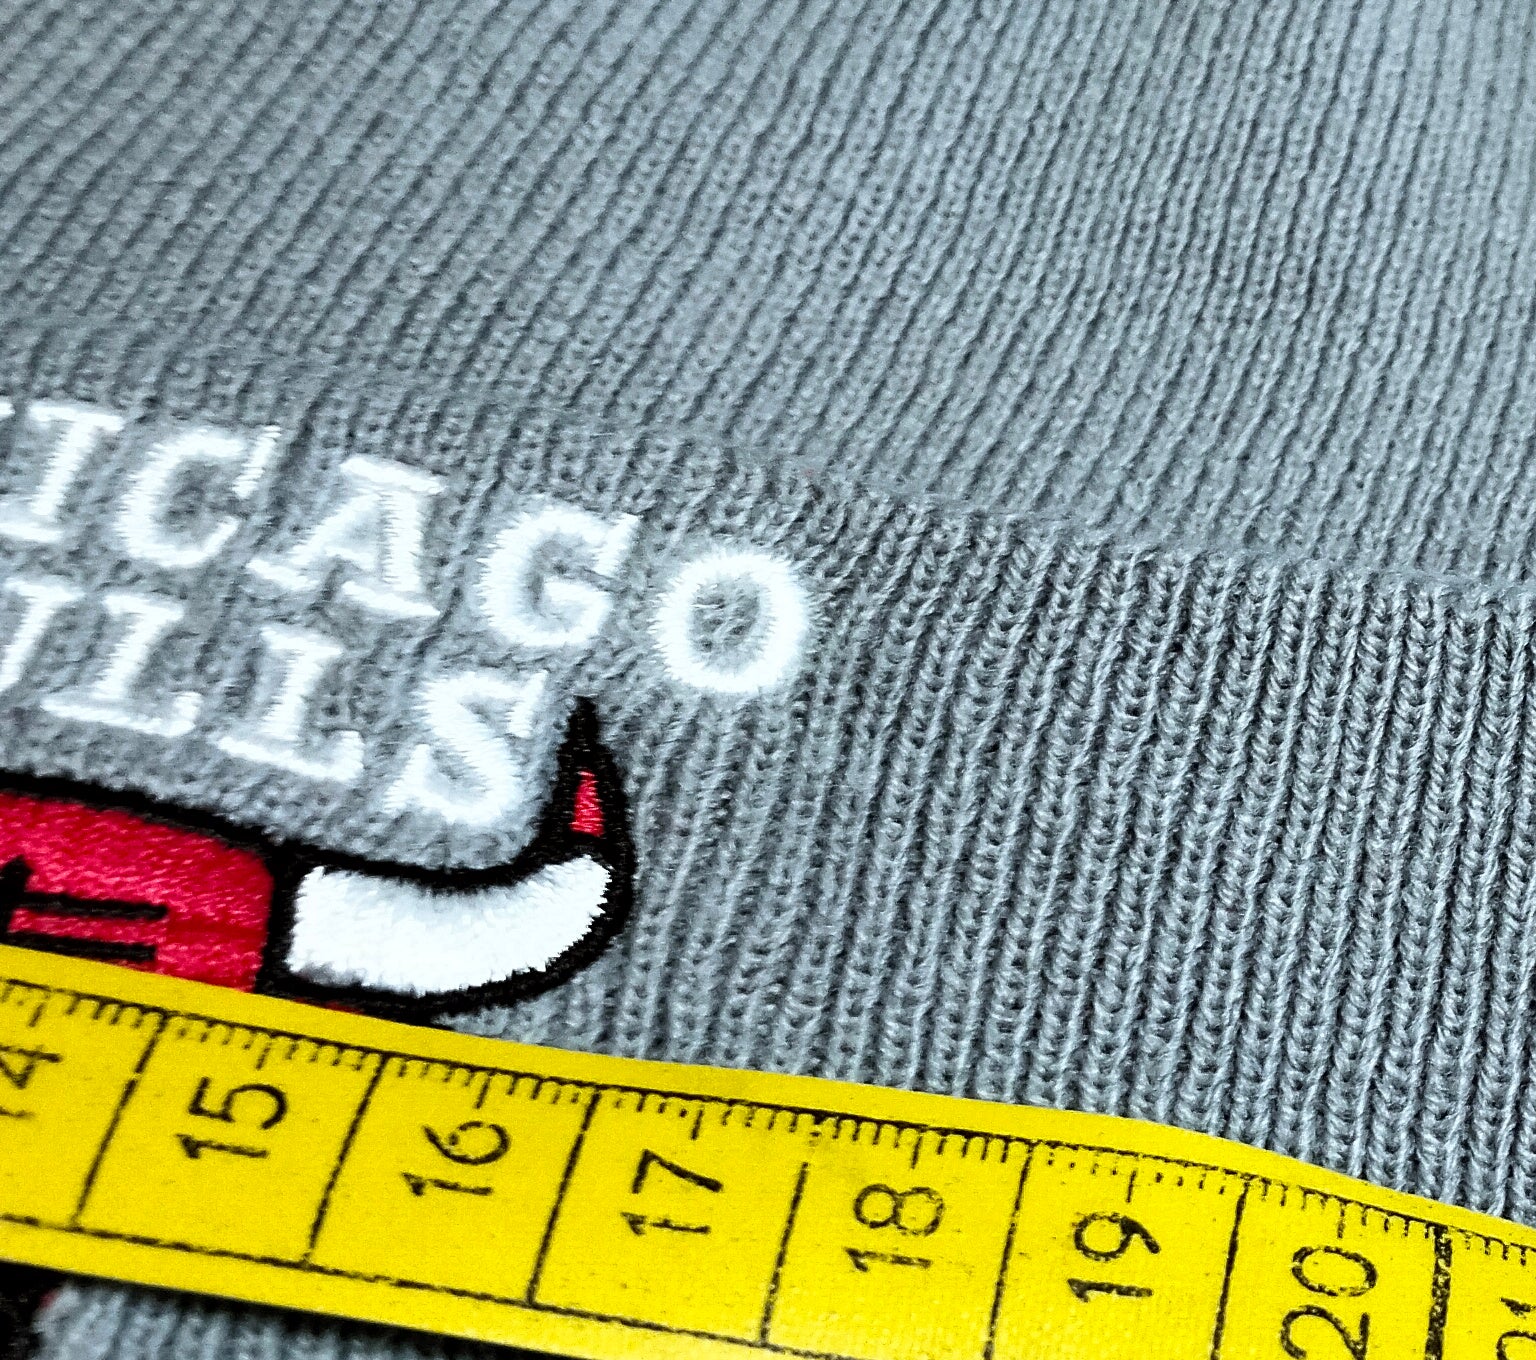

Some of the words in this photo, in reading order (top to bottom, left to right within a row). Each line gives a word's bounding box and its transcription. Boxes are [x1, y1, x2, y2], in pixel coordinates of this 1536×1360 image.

[0, 397, 812, 695] ICAGO
[172, 1076, 288, 1159] 15
[401, 1120, 512, 1197] 16
[620, 1149, 722, 1238] 17
[844, 1182, 945, 1274] 18
[1067, 1211, 1161, 1304] 19
